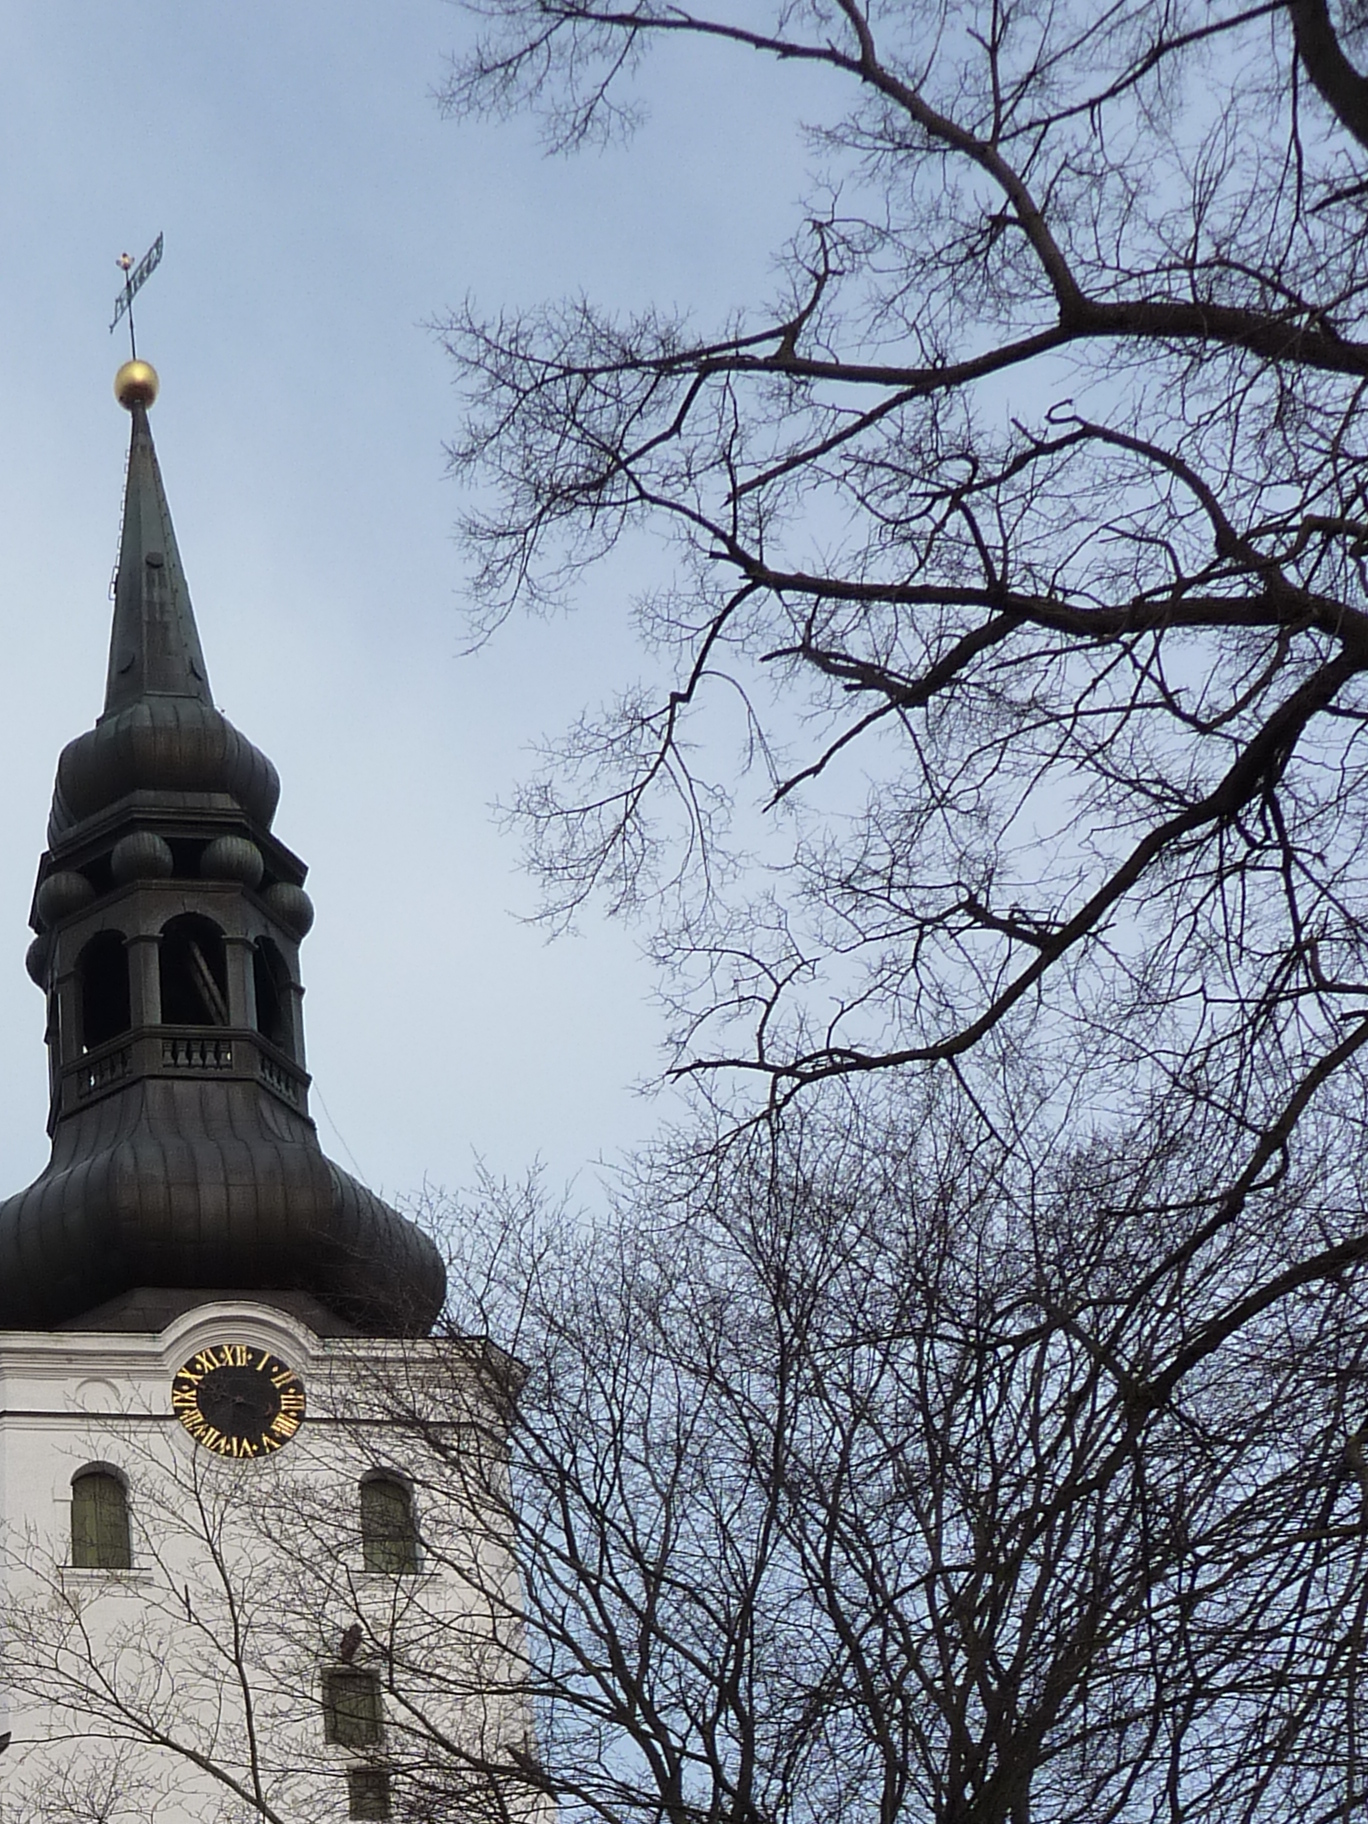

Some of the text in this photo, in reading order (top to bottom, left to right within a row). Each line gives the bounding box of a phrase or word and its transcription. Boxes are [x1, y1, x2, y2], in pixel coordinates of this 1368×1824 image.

[195, 1348, 222, 1373] XI
[222, 1345, 248, 1367] XII
[256, 1352, 271, 1371] I
[178, 1367, 204, 1385] X
[271, 1370, 297, 1389] II
[173, 1389, 197, 1408] IX
[280, 1394, 305, 1411] III
[202, 1427, 228, 1454] VII
[232, 1437, 254, 1458] VI
[261, 1433, 282, 1453] V
